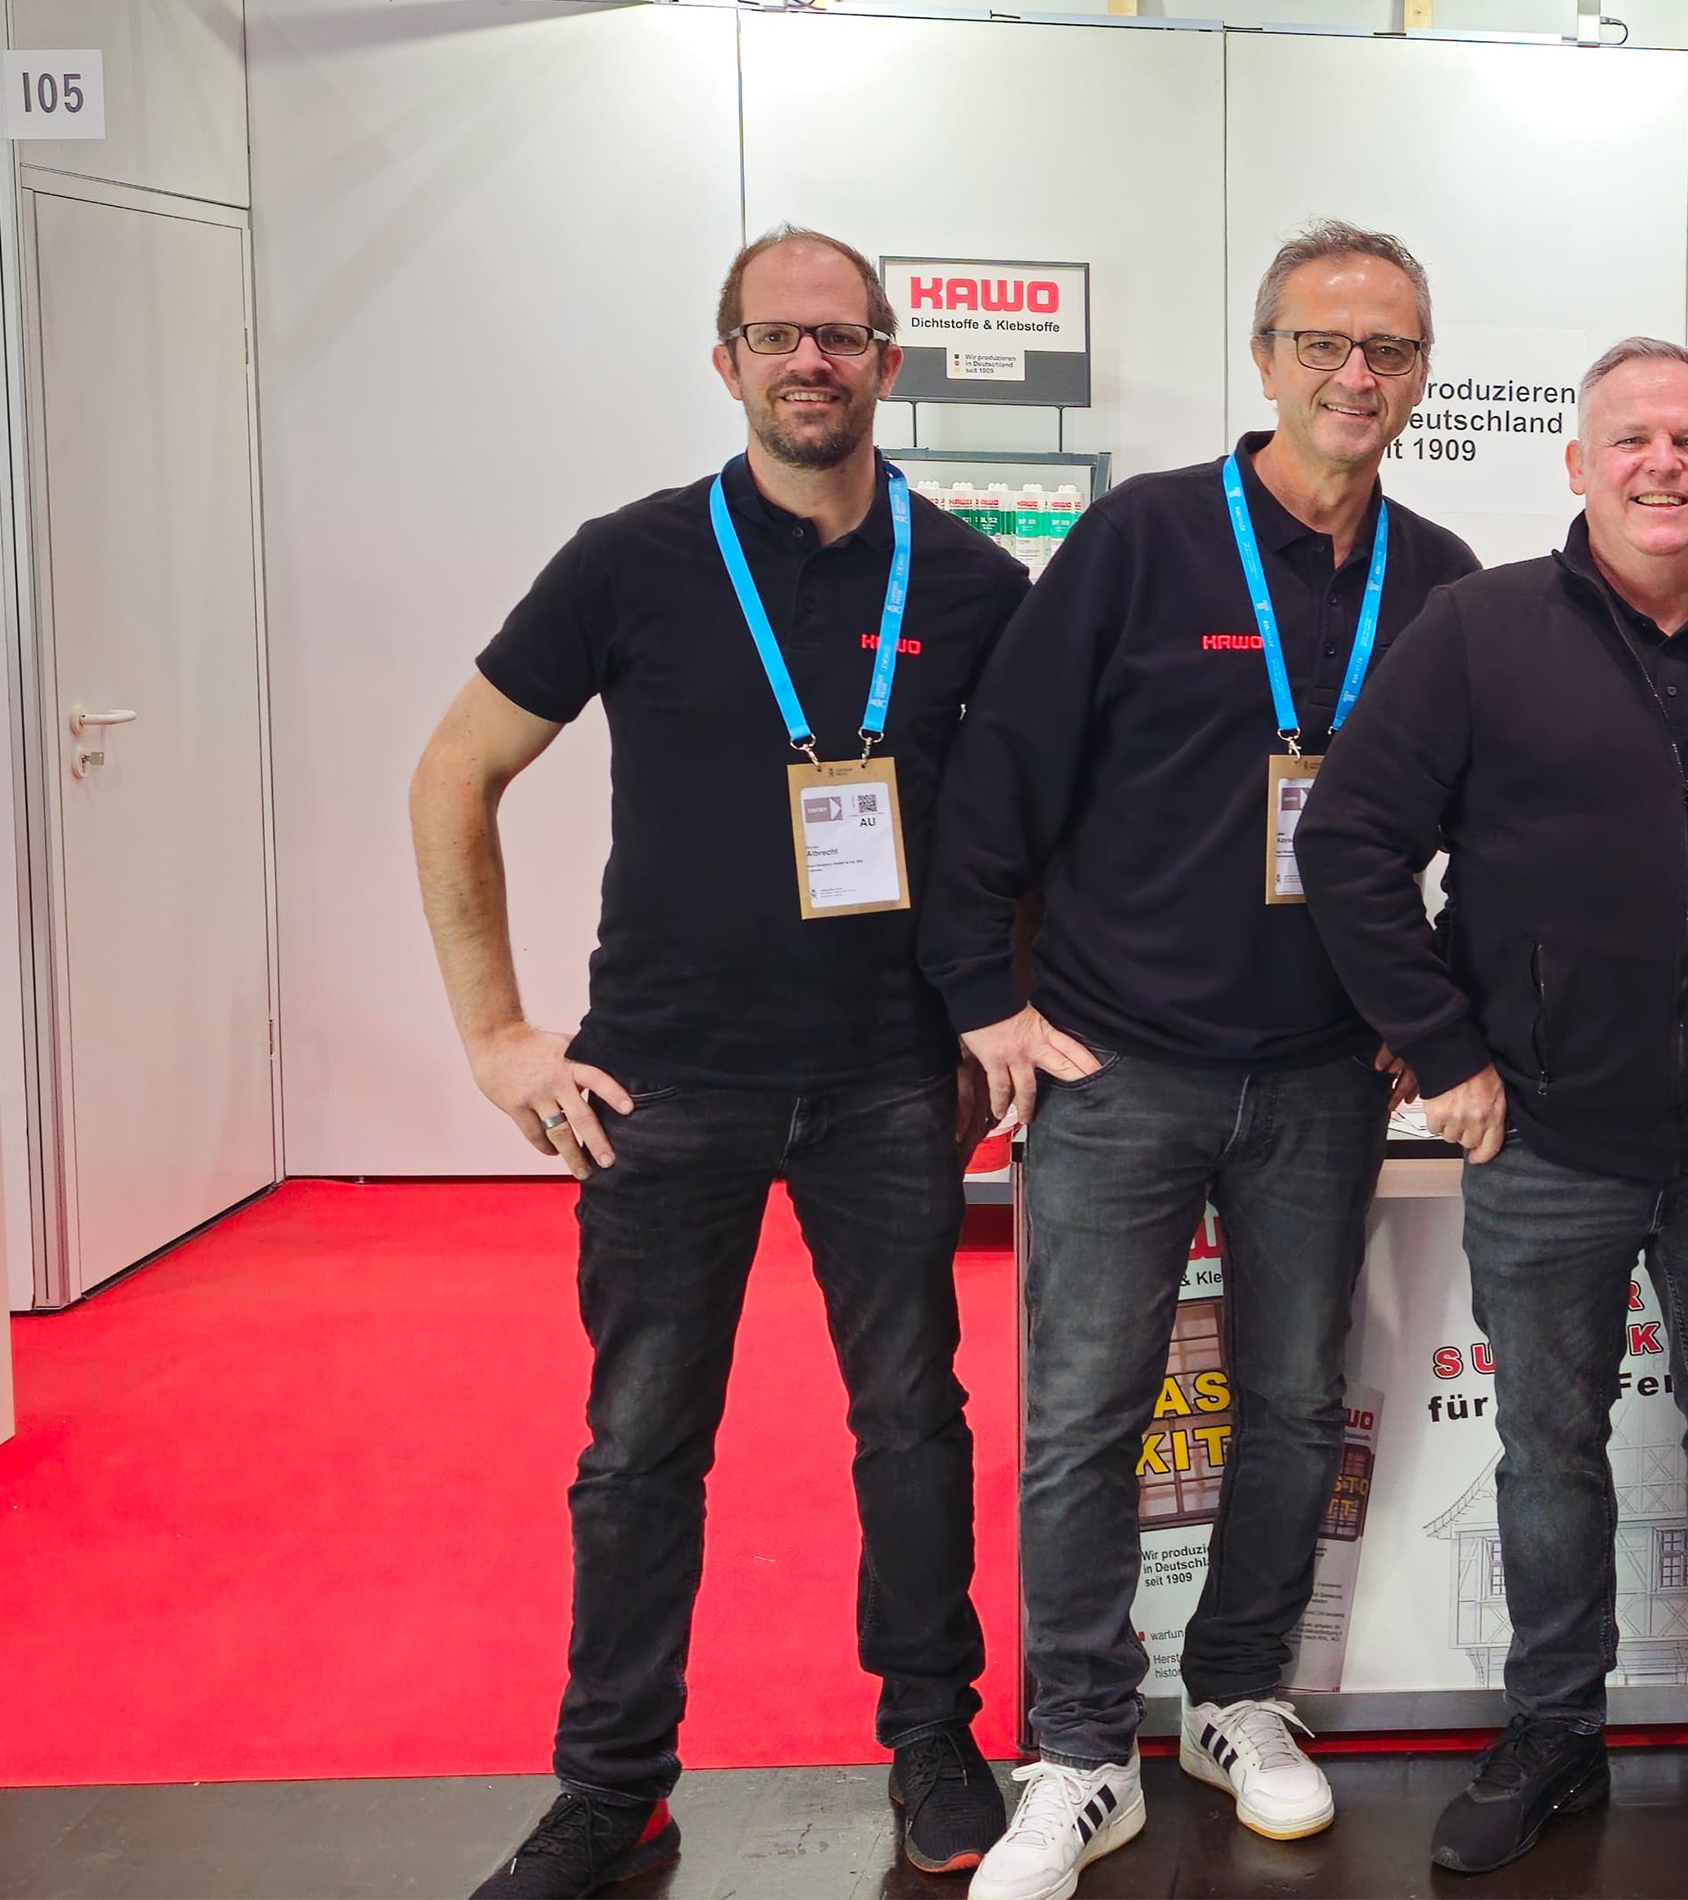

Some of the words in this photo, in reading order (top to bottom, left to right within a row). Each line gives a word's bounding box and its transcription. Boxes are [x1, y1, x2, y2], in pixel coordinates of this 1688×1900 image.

[910, 276, 1059, 313] KAWO
[911, 317, 979, 330] Dichtstoffe
[983, 319, 992, 330] &
[996, 320, 1060, 333] Klebstoffe
[1427, 378, 1577, 404] roduzieren
[1409, 410, 1564, 434] eutschland
[1413, 438, 1477, 462] 1909
[1202, 634, 1264, 650] KAWO
[860, 817, 876, 827] AU
[1196, 1271, 1222, 1285] Kle
[1153, 1370, 1231, 1418] AS
[1428, 1394, 1489, 1423] für
[1136, 1425, 1232, 1476] KIT
[1162, 1544, 1210, 1561] produzi
[1143, 1564, 1153, 1574] in
[1155, 1557, 1210, 1573] Deutschl
[1145, 1576, 1163, 1588] seit
[1167, 1572, 1193, 1585] 1909
[1150, 1629, 1185, 1641] wartun
[1153, 1653, 1181, 1664] Herst
[1155, 1667, 1181, 1679] histo
